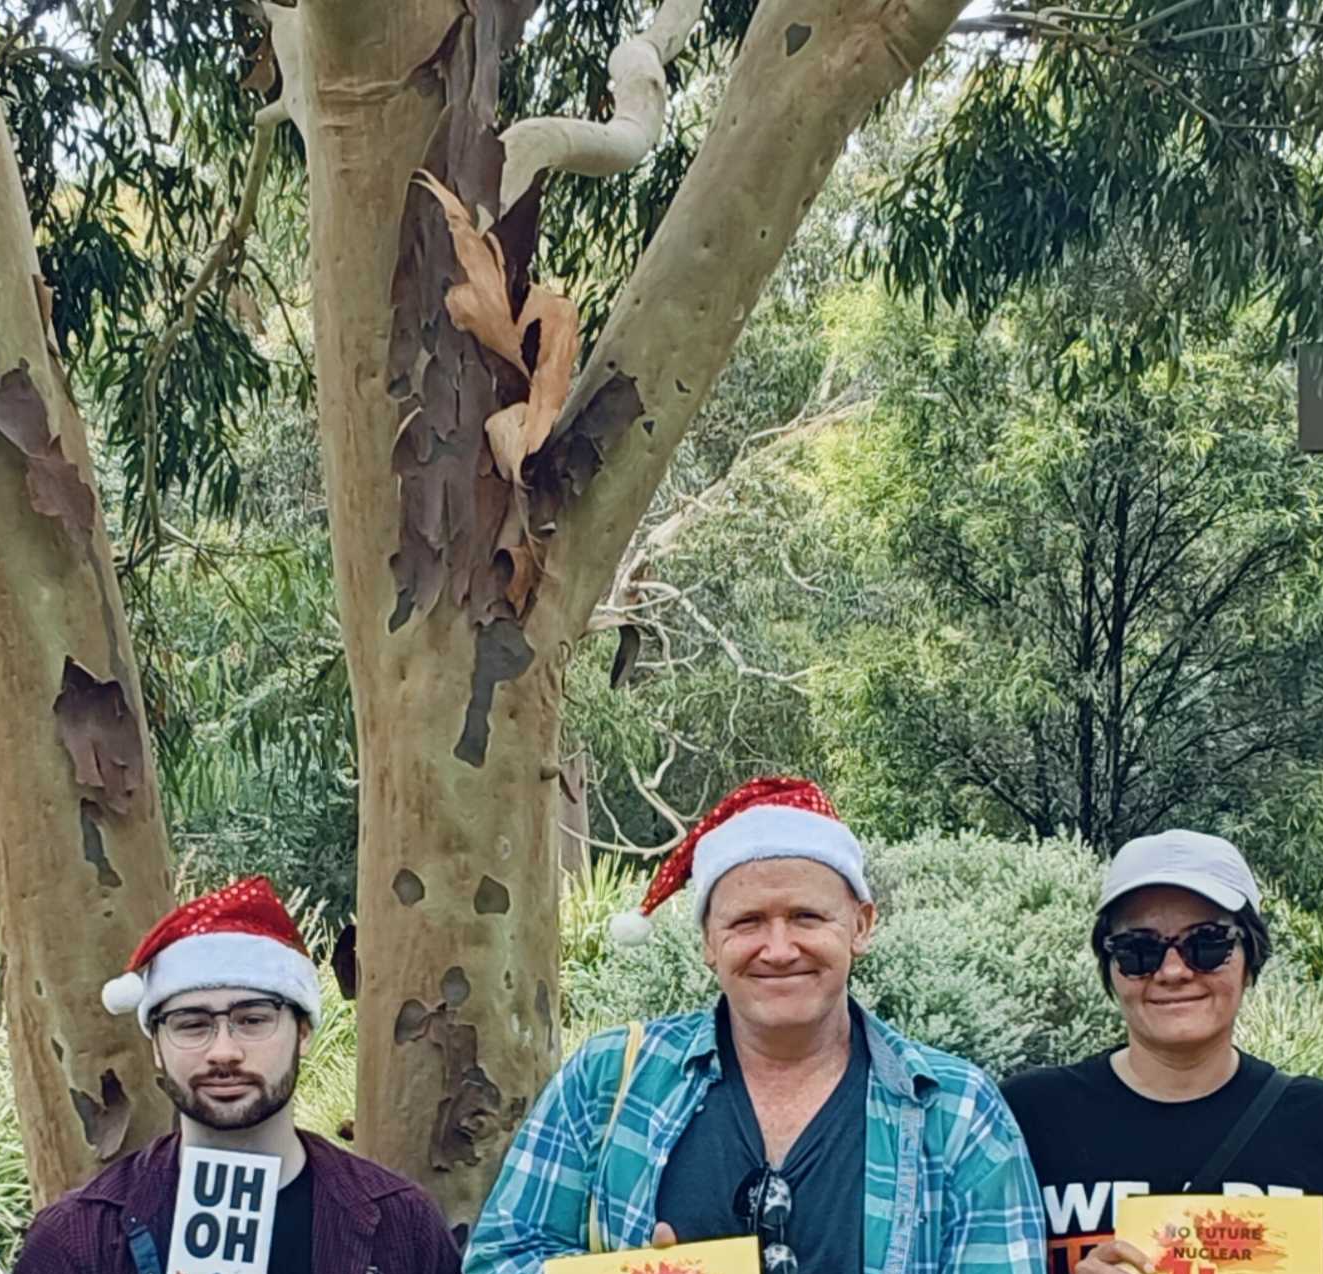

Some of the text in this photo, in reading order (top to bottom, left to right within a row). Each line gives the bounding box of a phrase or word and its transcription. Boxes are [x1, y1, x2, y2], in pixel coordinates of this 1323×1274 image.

[193, 1161, 266, 1212] UH
[184, 1212, 260, 1264] OH
[1166, 1224, 1263, 1241] NO FUTURE
[1173, 1247, 1252, 1261] NUCLEAR
